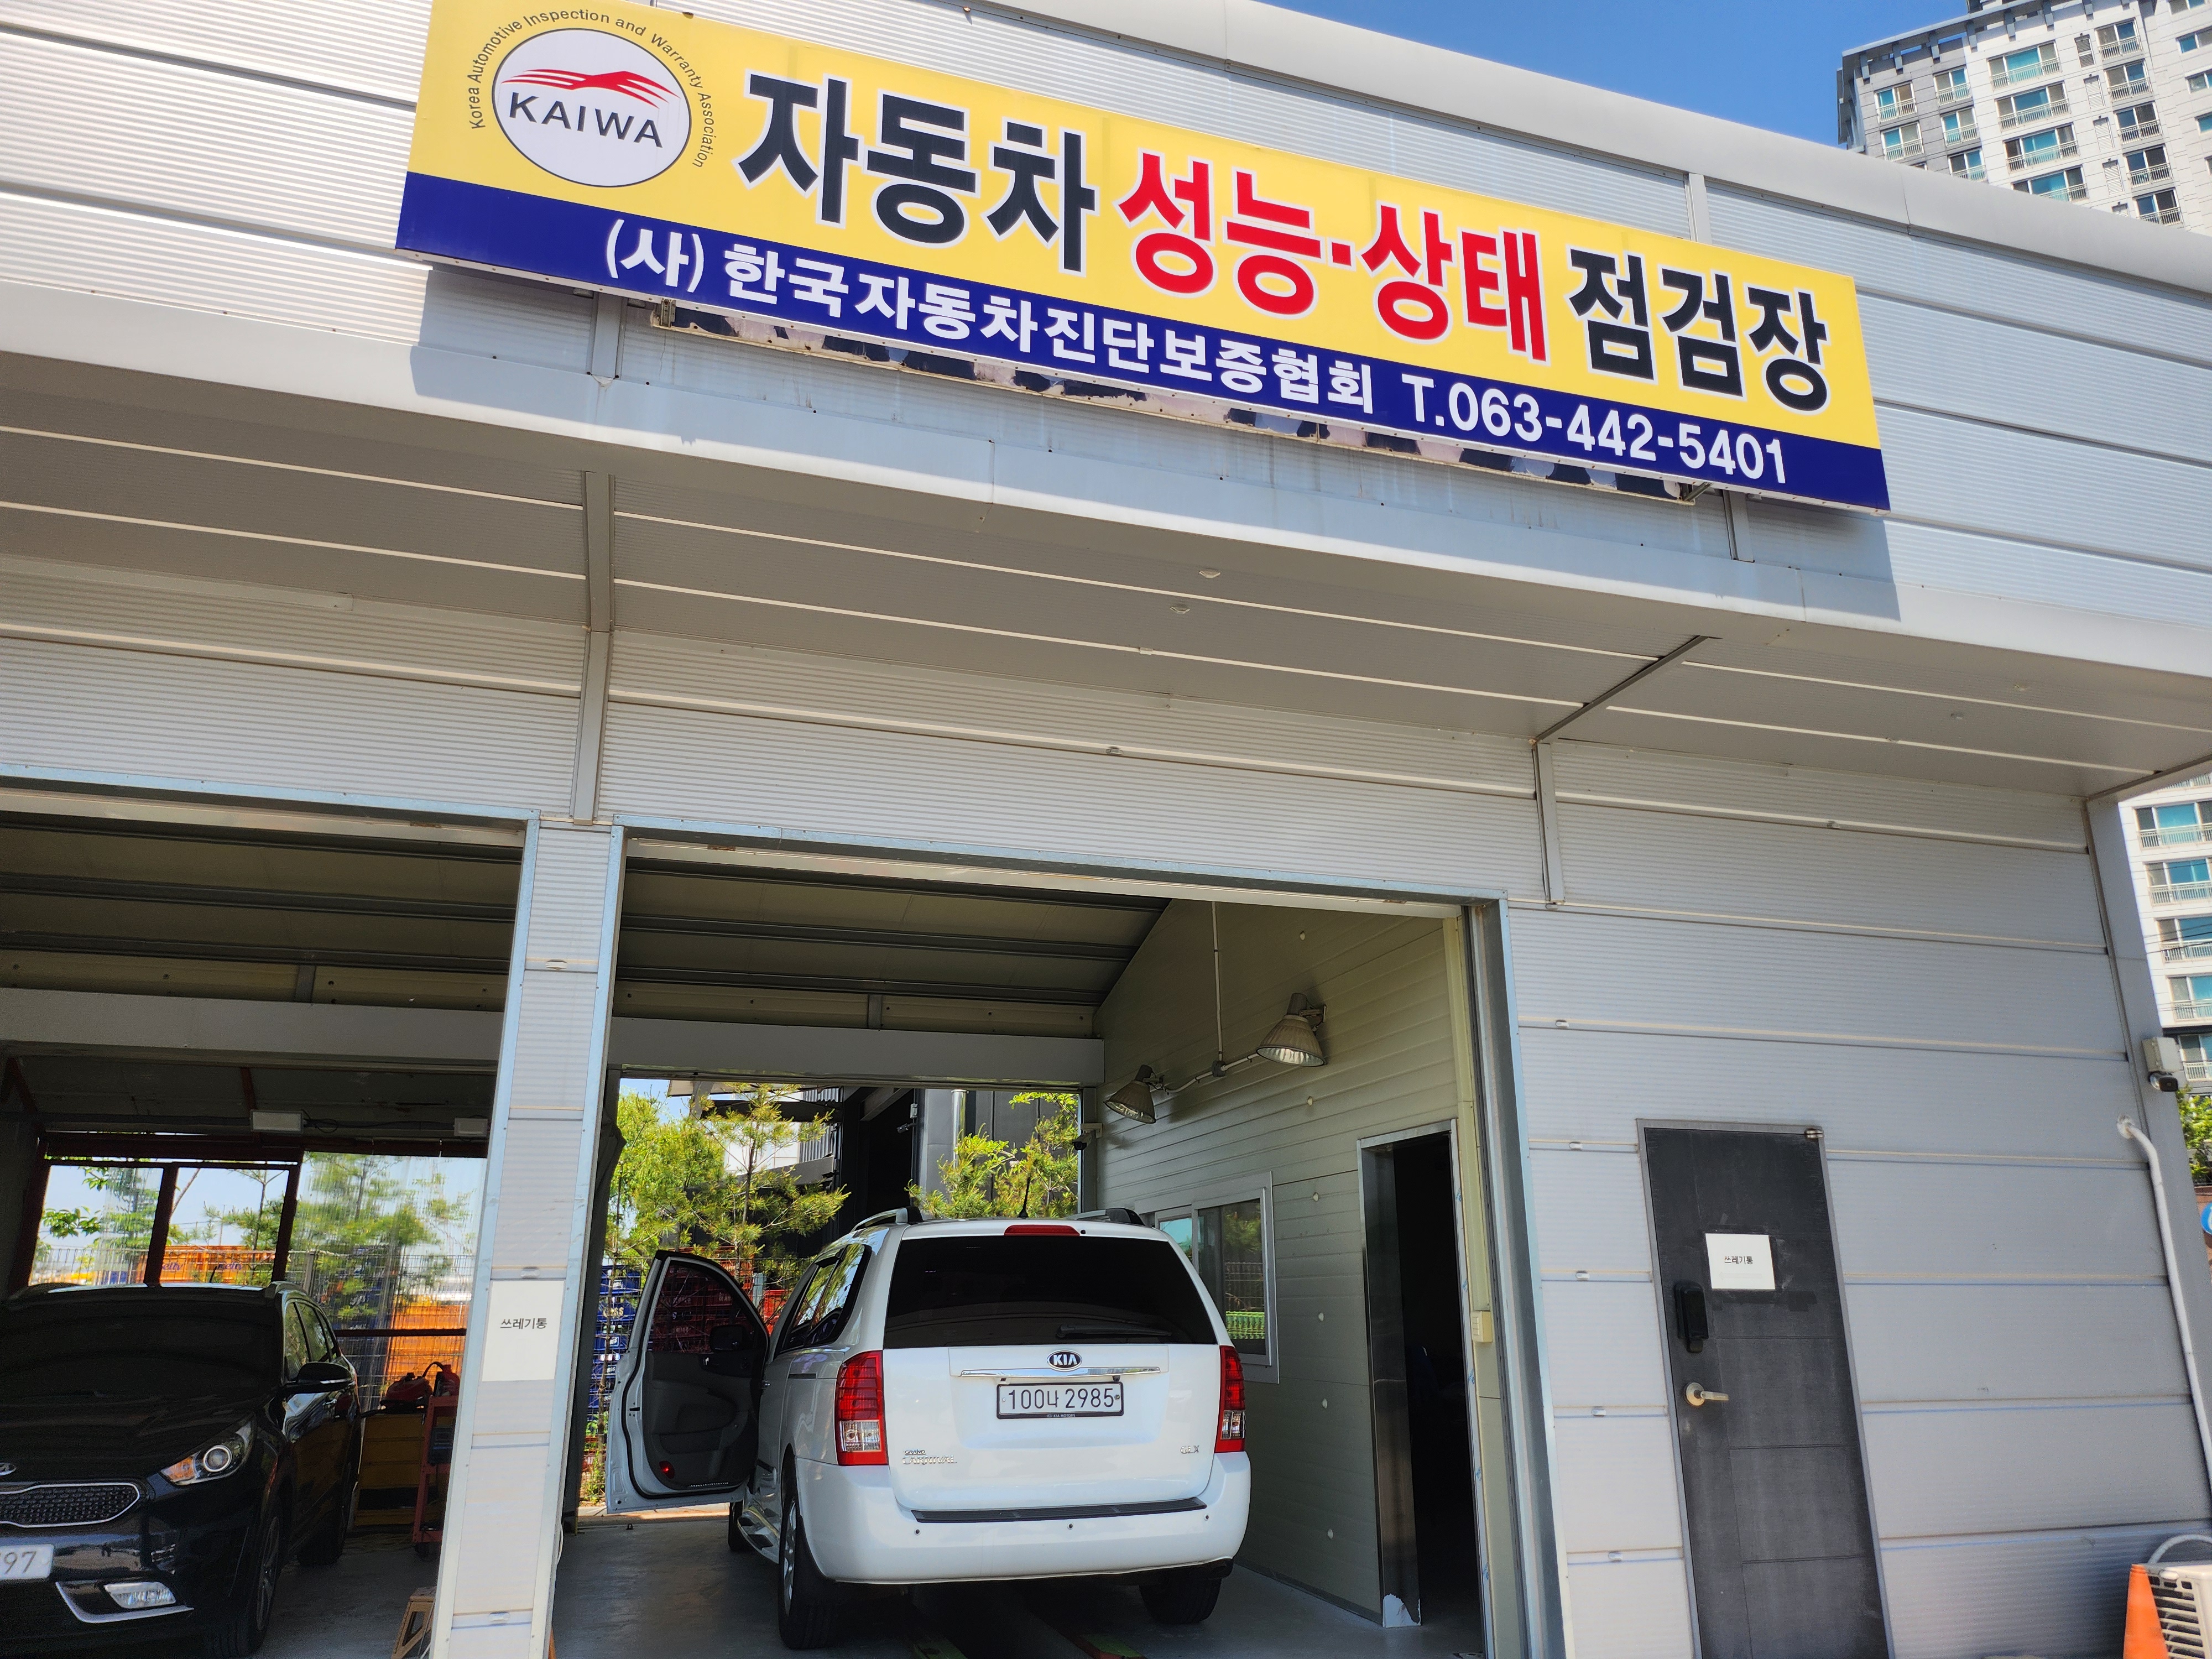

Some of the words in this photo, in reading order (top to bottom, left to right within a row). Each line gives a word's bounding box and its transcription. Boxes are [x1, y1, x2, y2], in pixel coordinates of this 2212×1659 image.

[523, 9, 610, 27] Inspection
[615, 18, 646, 36] and
[467, 20, 523, 83] Automotive
[651, 33, 703, 88] Warranty
[470, 87, 486, 129] Korea
[509, 92, 663, 148] KAIWA
[692, 91, 716, 168] Association
[738, 74, 1095, 273] 자동차
[1569, 248, 1828, 411] 점검장
[607, 219, 704, 293] (사)
[724, 244, 1373, 414] 한국자동차진단보증협회
[1401, 373, 1786, 483] T.063-442-5401
[1724, 1256, 1753, 1265] 쓰레기통
[500, 1318, 547, 1329] 쓰레기통
[1053, 1354, 1078, 1365] KIA
[1009, 1389, 1058, 1410] 100나
[1065, 1388, 1114, 1408] 2985
[901, 1455, 957, 1465] CARNIVAL
[1180, 1445, 1199, 1454] GLX
[0, 1551, 36, 1574] 97
